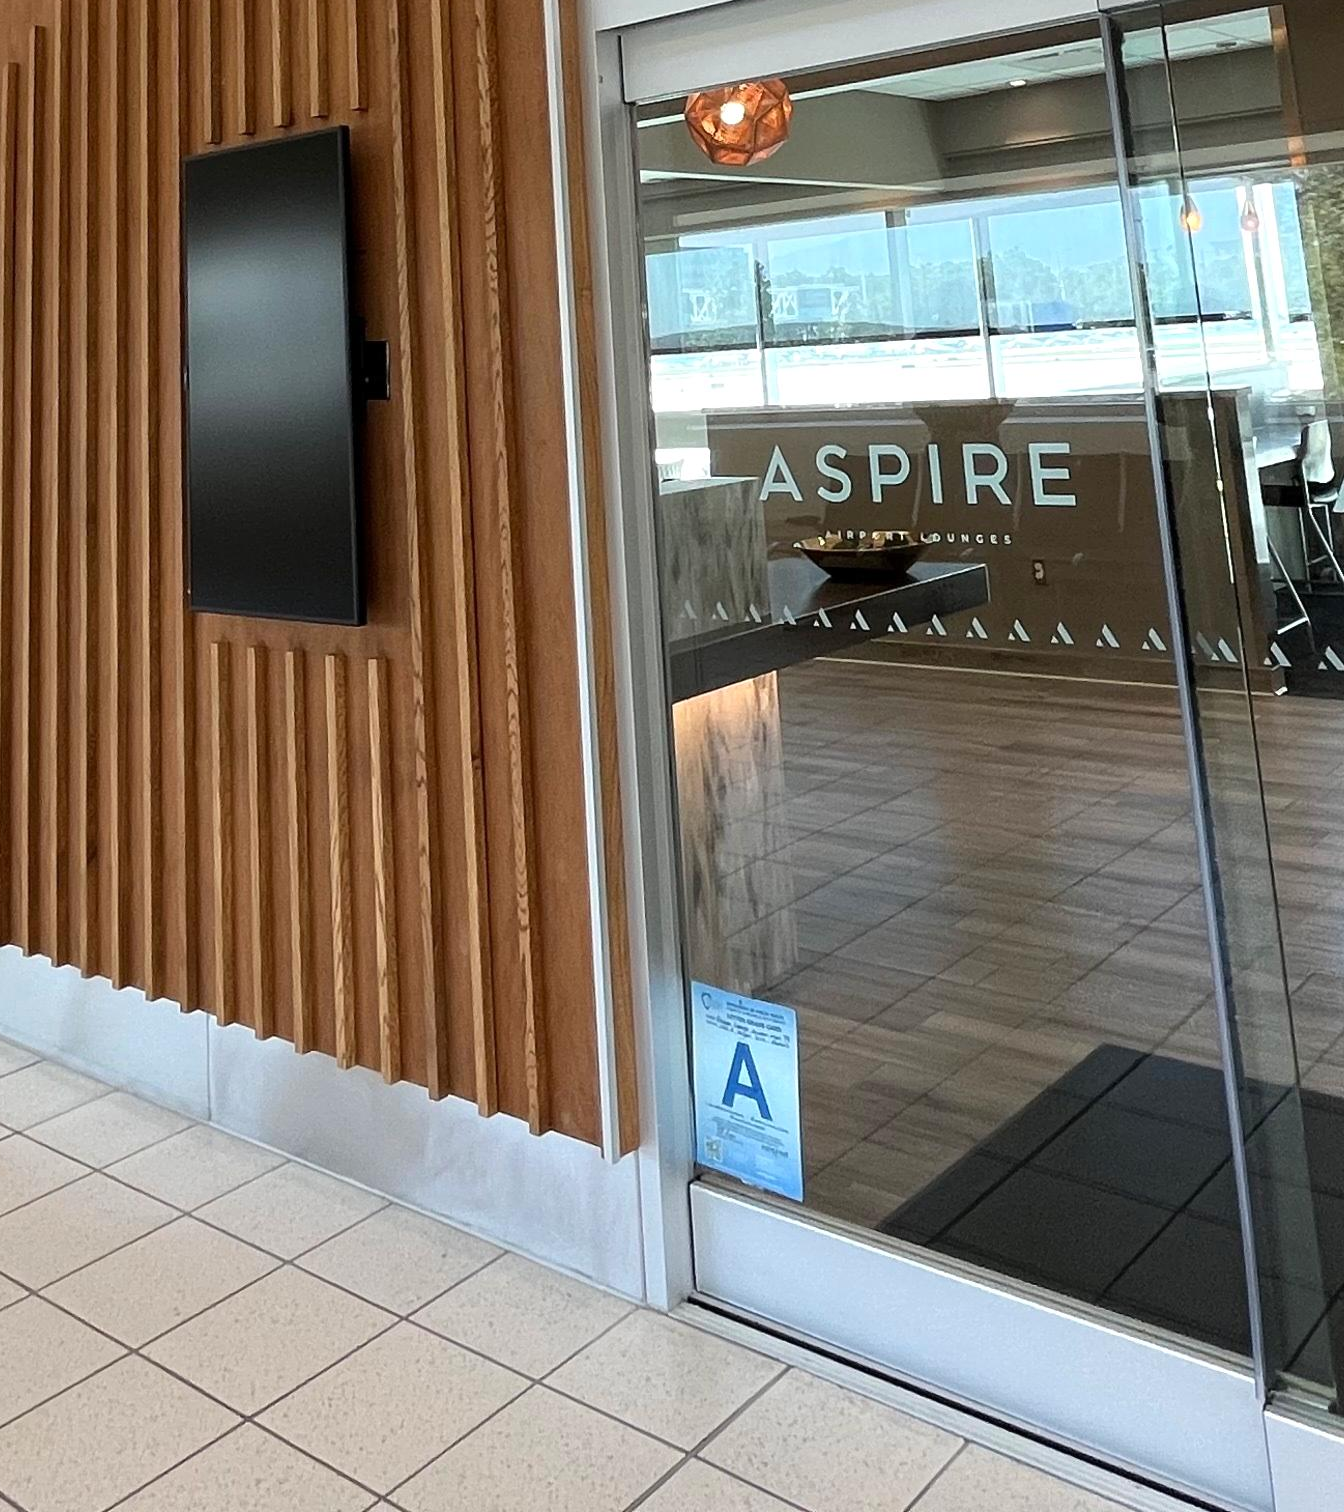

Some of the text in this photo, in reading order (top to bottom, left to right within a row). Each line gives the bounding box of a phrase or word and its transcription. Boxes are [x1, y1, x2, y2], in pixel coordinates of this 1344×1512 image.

[758, 442, 1077, 507] ASPIRE
[825, 529, 1012, 545] AIRPORT LOUNGES
[722, 1041, 773, 1122] A
